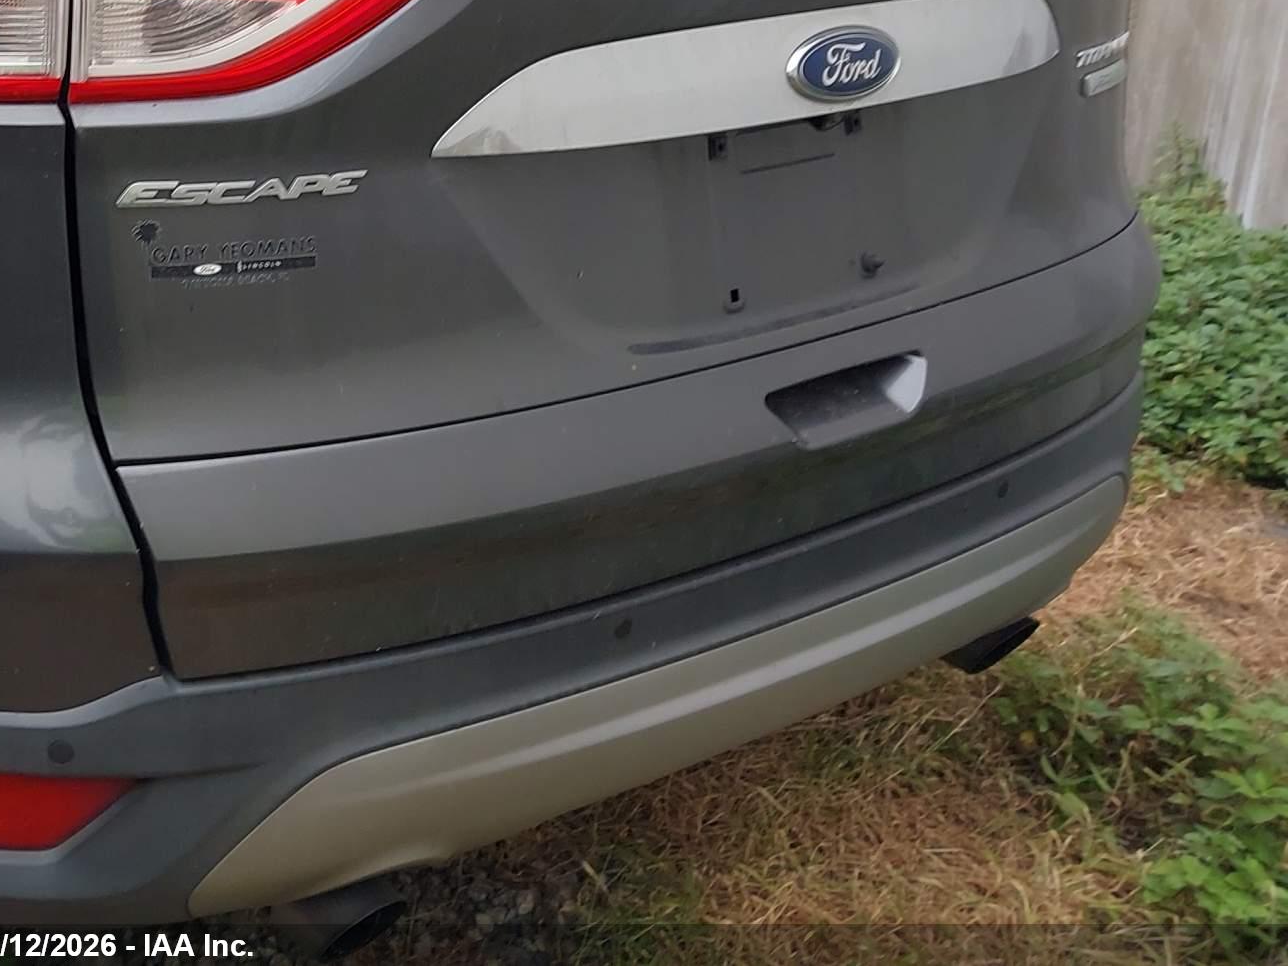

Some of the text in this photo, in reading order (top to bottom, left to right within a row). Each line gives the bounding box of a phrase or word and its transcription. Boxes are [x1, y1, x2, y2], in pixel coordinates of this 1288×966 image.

[822, 42, 882, 88] Ford
[115, 170, 368, 208] ESCAPE
[151, 236, 317, 264] GARY YEOMANS
